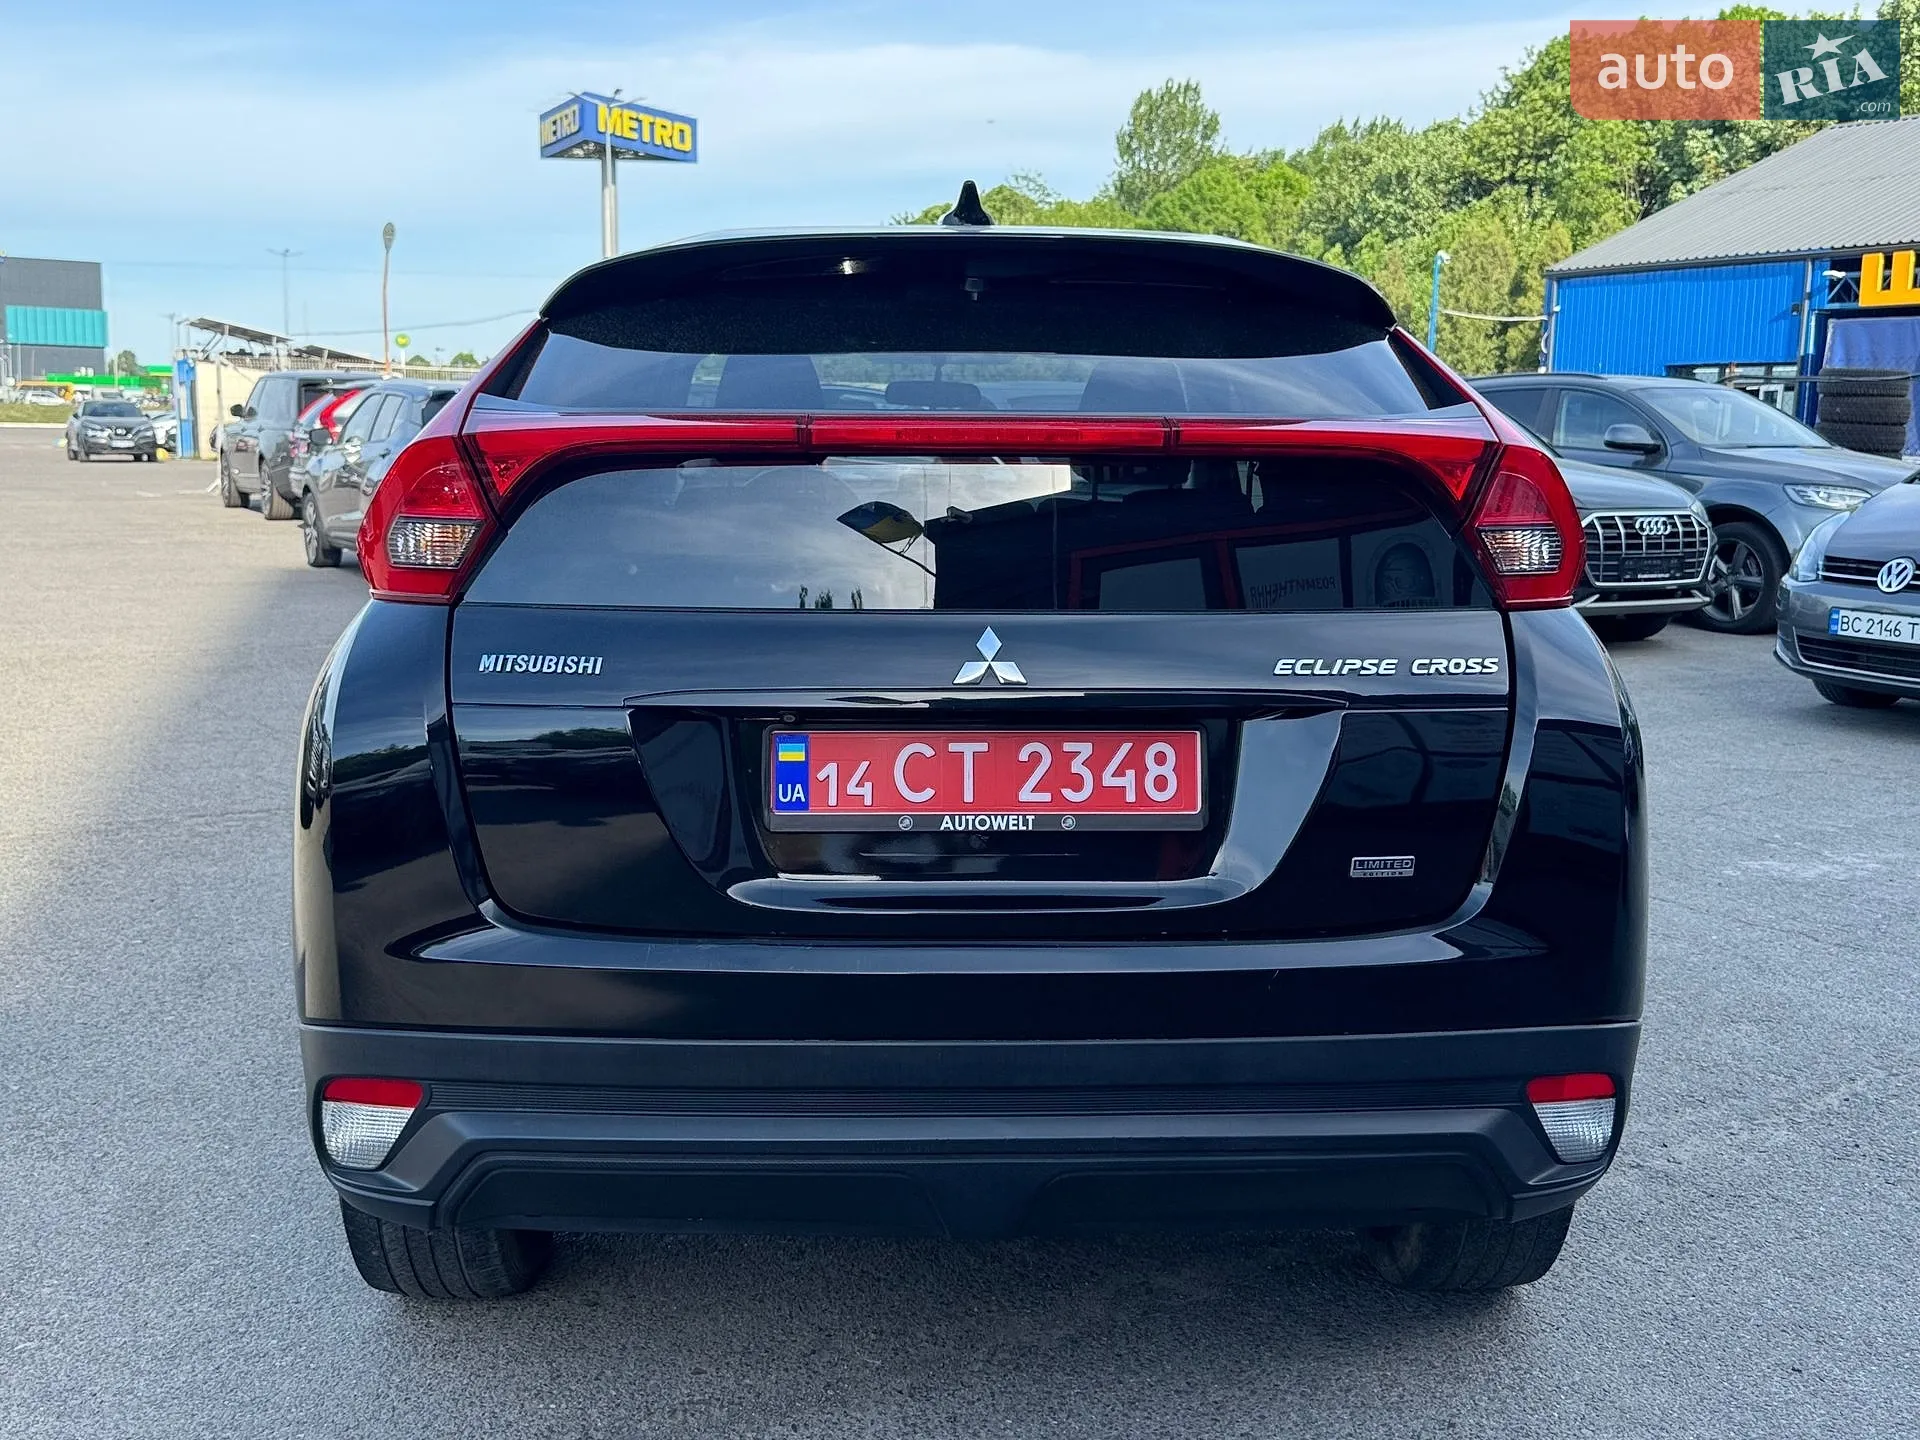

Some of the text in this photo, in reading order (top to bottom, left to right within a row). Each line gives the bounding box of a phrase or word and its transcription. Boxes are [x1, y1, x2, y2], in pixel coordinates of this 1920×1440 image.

[541, 104, 579, 144] METRO
[597, 104, 692, 151] METRO
[1840, 615, 1862, 633] BC
[1866, 618, 1902, 638] 2146
[478, 654, 604, 675] MITSUBISHI
[1273, 657, 1500, 675] ECLIPSE CROSS
[815, 741, 1177, 807] 14 CT 2348
[778, 784, 806, 803] UA
[939, 815, 1035, 831] AUTOWELT
[1355, 860, 1412, 868] LIMITED
